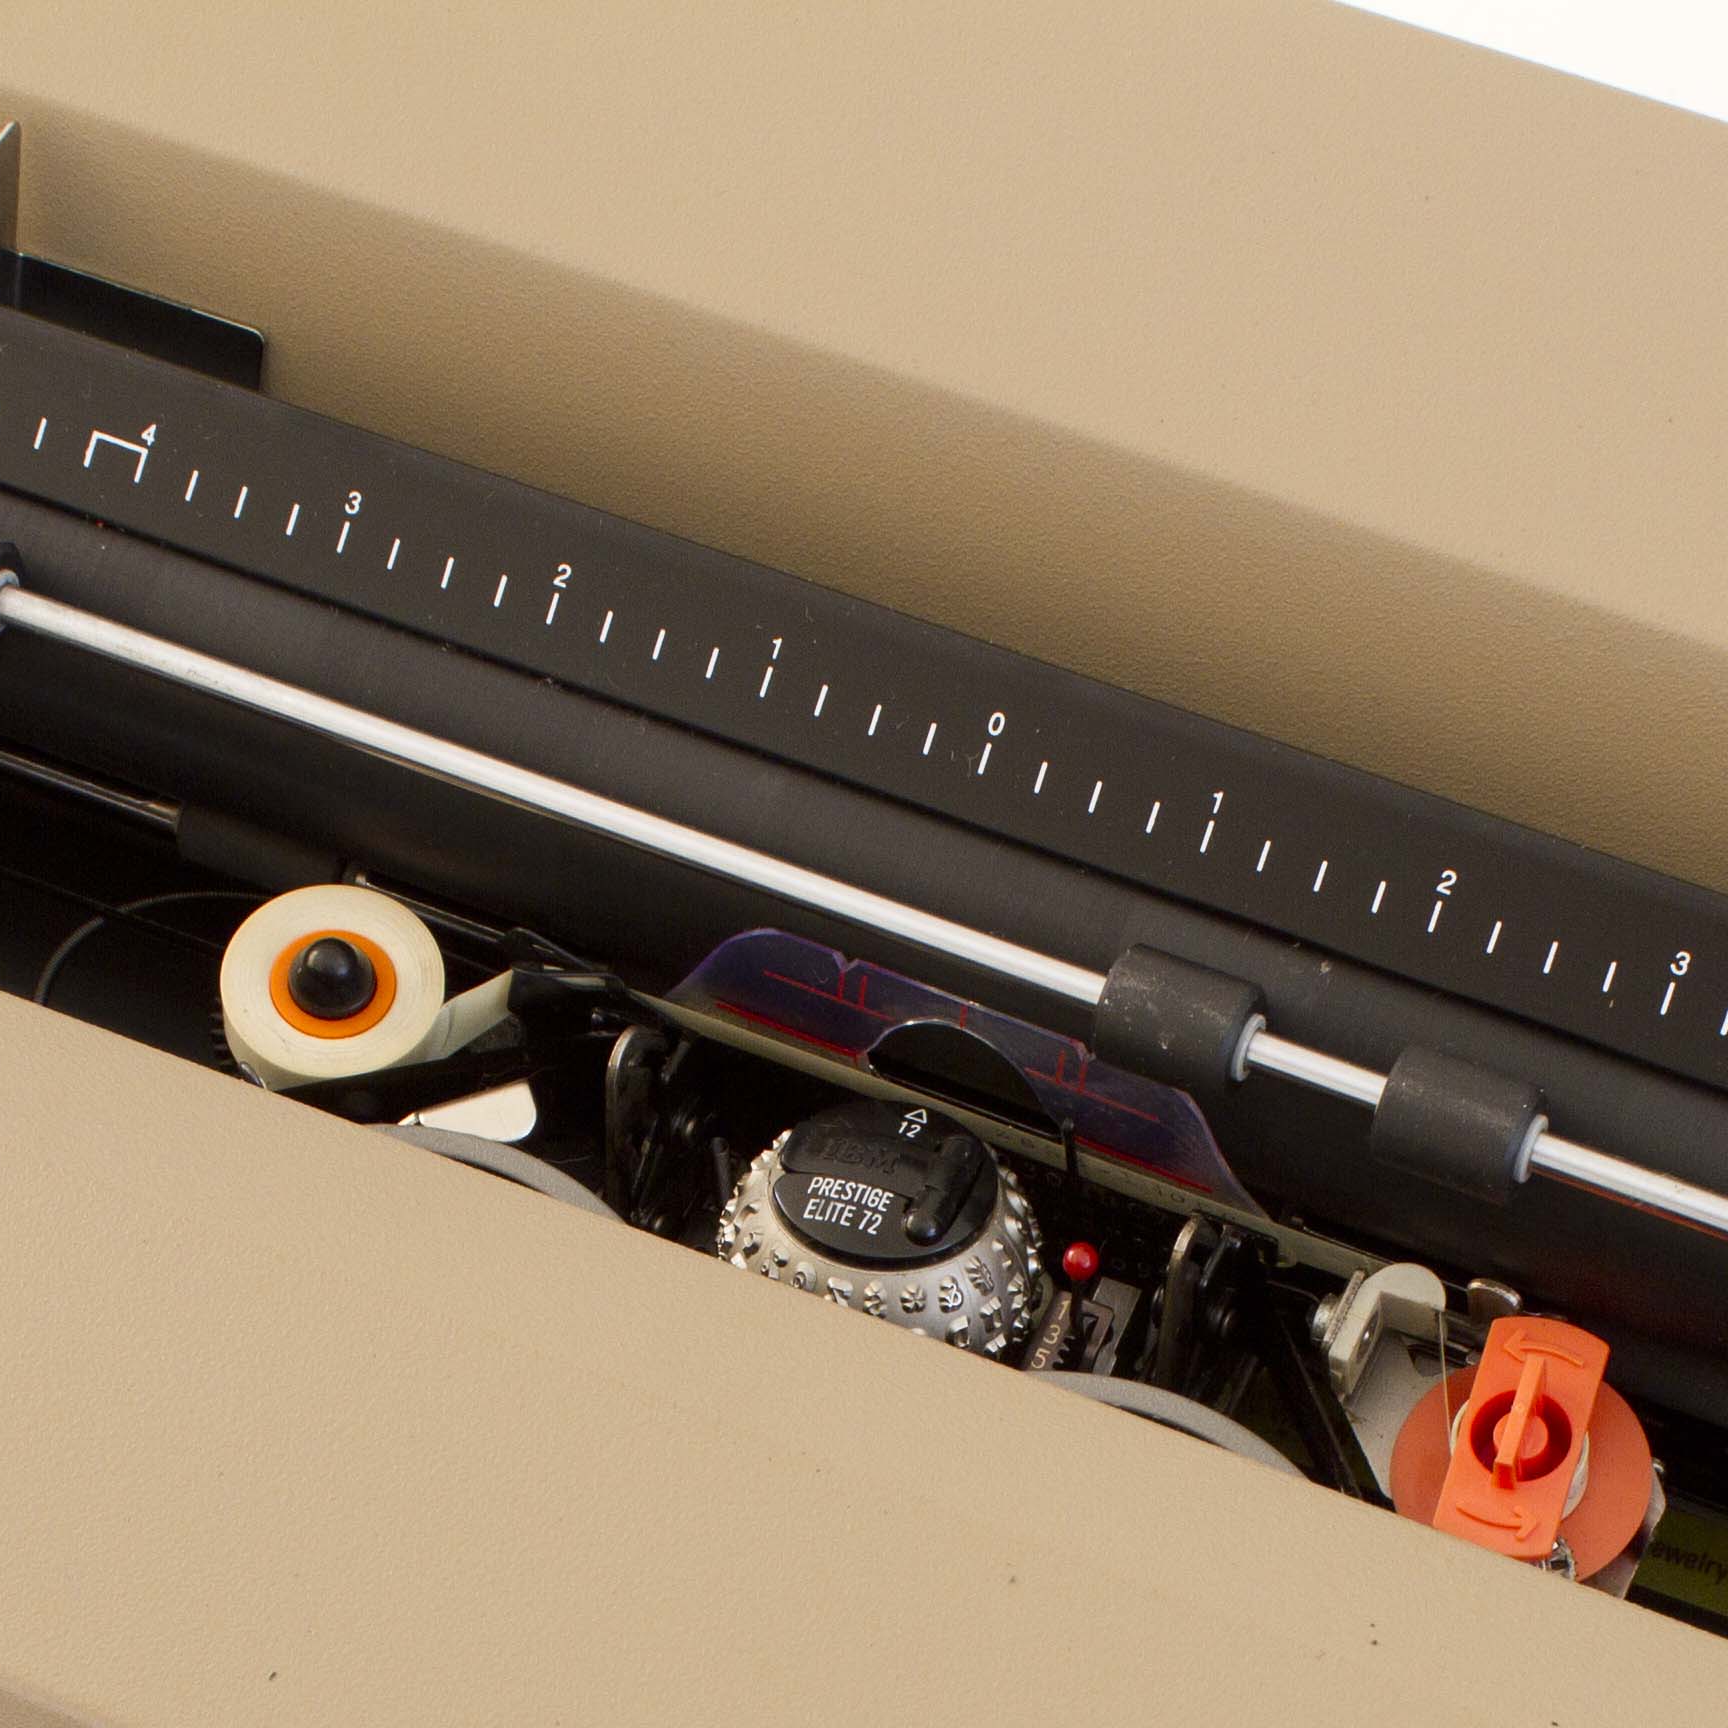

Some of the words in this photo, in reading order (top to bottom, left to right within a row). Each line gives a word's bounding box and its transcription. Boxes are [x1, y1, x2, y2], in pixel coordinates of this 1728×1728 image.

[141, 423, 157, 446] 4
[344, 491, 362, 515] 3
[553, 563, 572, 588] 2
[772, 637, 783, 660] 1
[987, 712, 1006, 736] 0
[1213, 791, 1224, 814] 1
[1436, 869, 1457, 896] 2
[1670, 951, 1691, 976] 3
[898, 1121, 922, 1138] 12
[822, 1139, 899, 1176] IBM
[807, 1177, 894, 1210] PRESTIGE
[802, 1198, 857, 1227] ELITE
[858, 1209, 883, 1235] 72
[1057, 1299, 1071, 1321] 1
[1043, 1324, 1061, 1345] 3
[1031, 1347, 1051, 1369] 5
